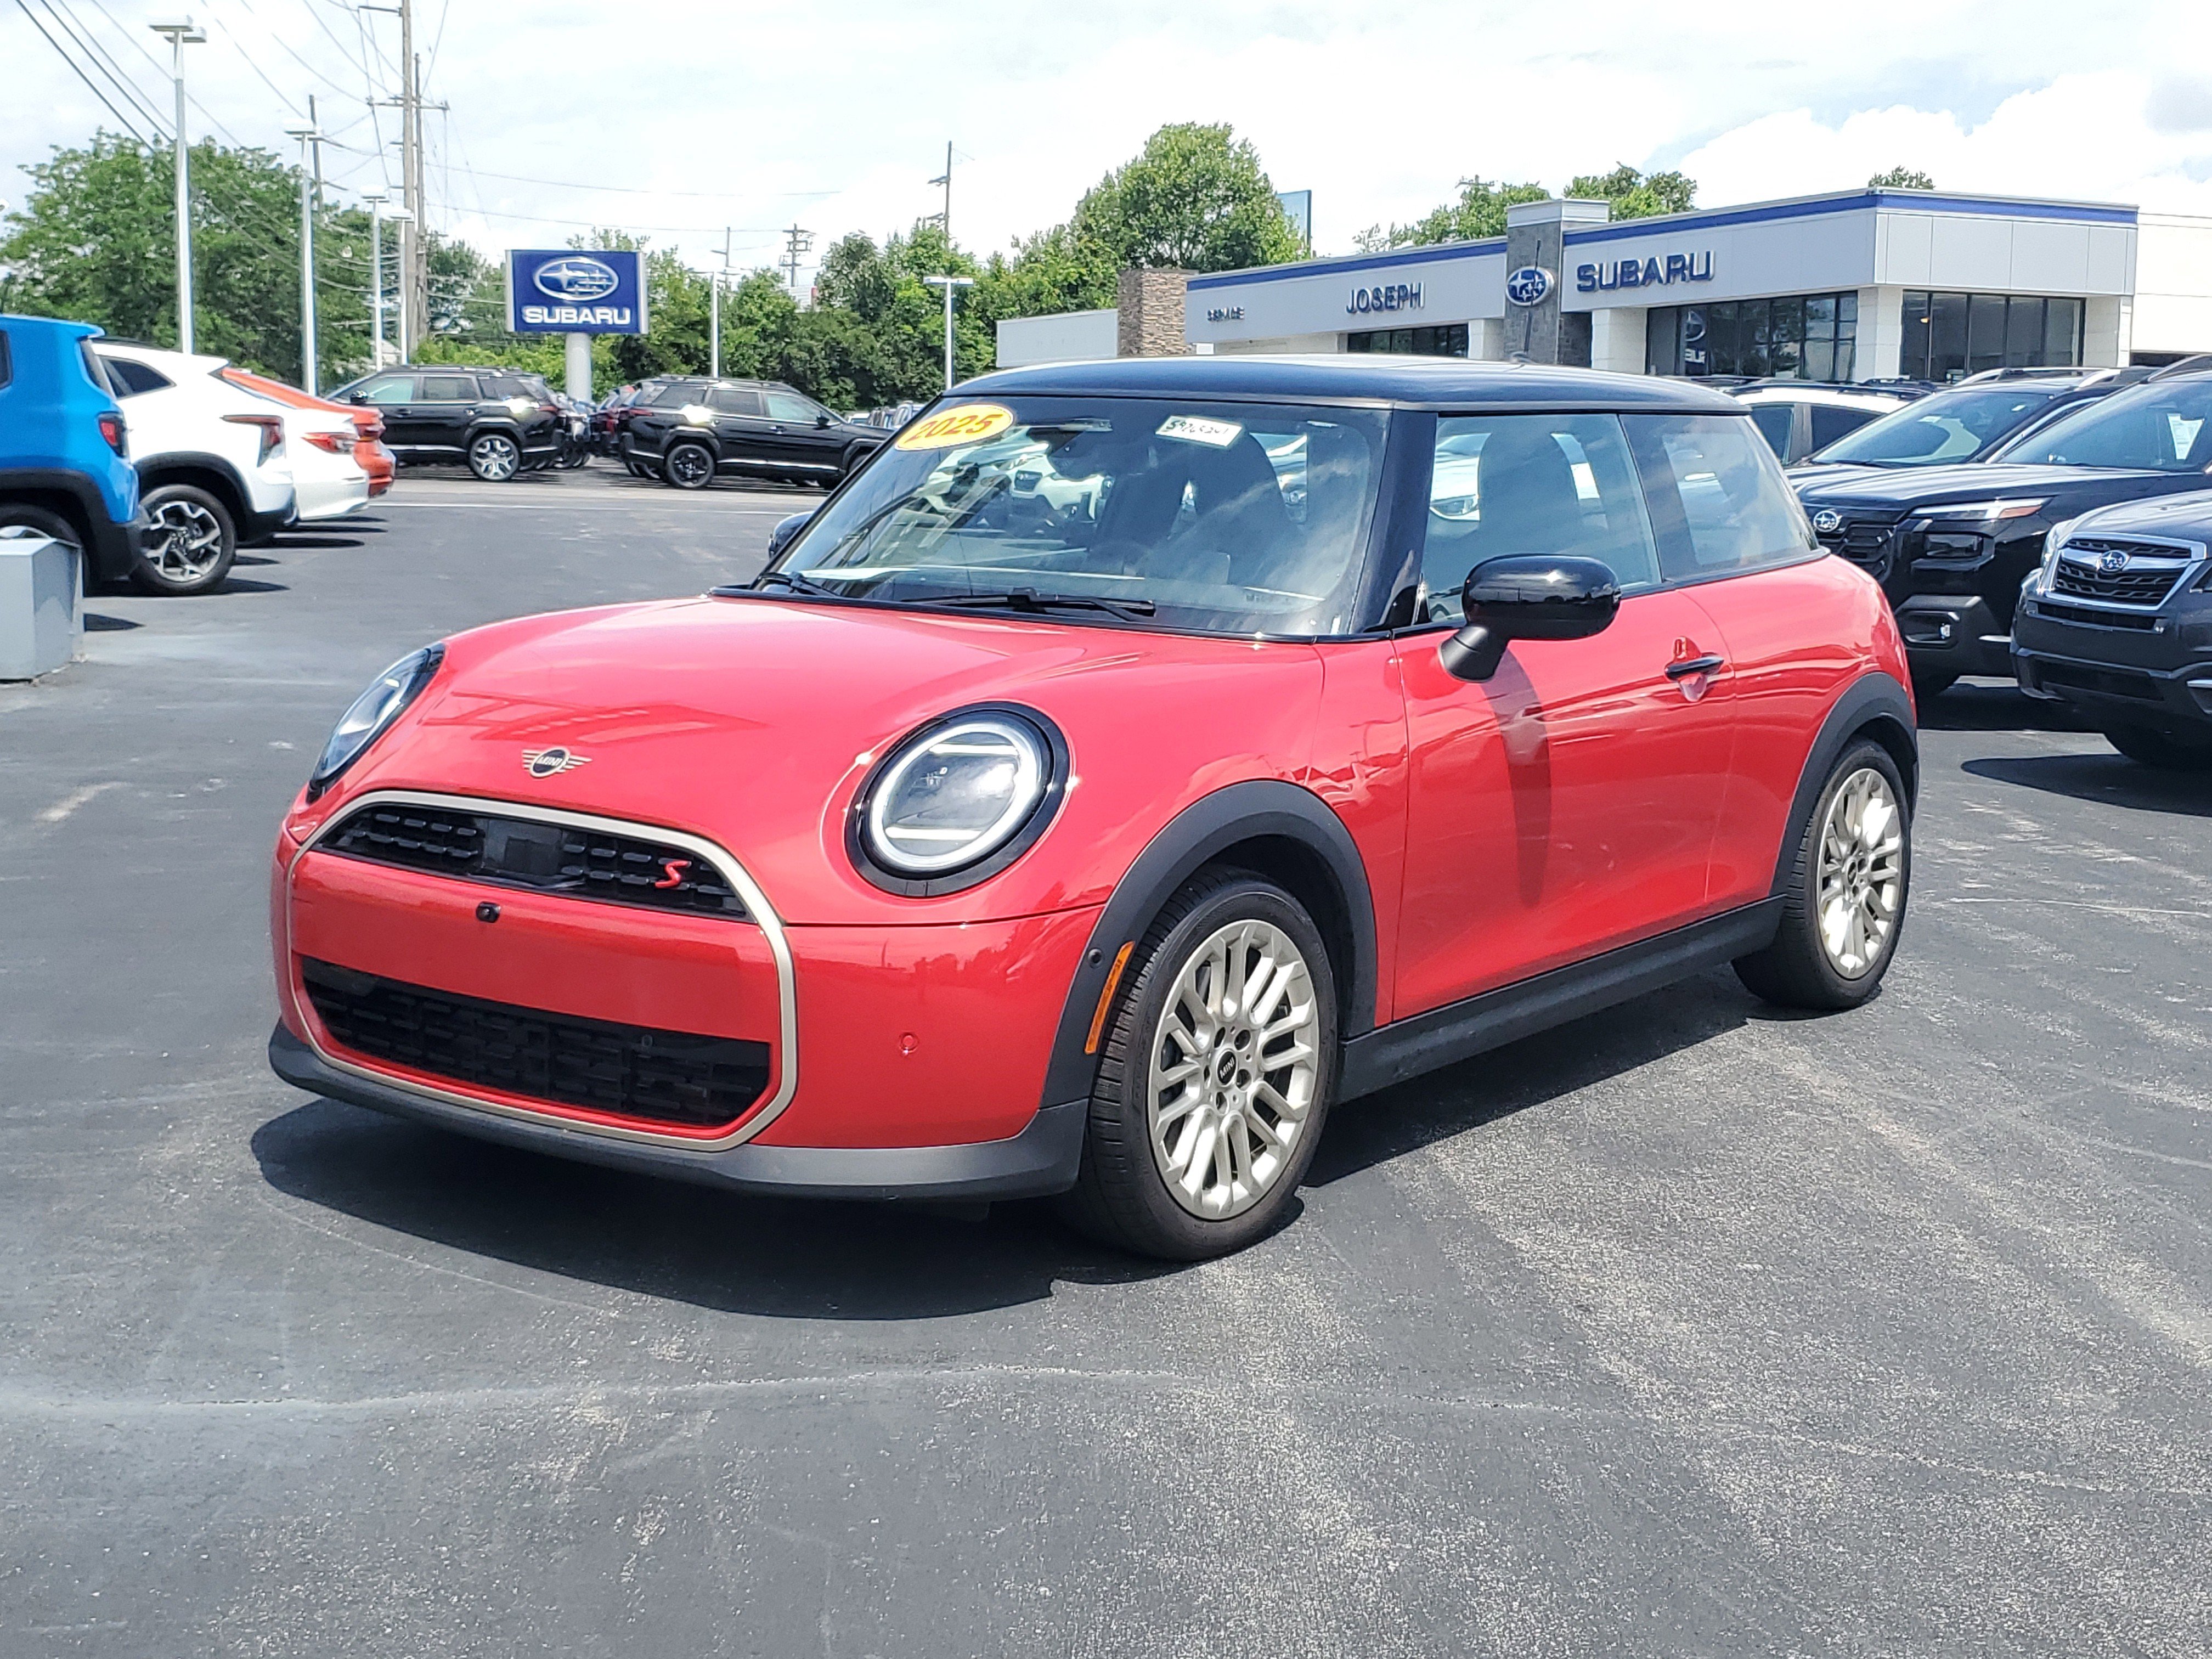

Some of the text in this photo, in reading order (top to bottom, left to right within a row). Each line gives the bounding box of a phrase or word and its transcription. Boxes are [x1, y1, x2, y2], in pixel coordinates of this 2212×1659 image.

[1577, 250, 1714, 292] SUBARU
[1346, 281, 1425, 314] JOSEPH
[522, 306, 630, 325] SUBARU
[904, 414, 1003, 444] 2025
[655, 860, 692, 889] S
[1220, 1057, 1235, 1079] MINI
